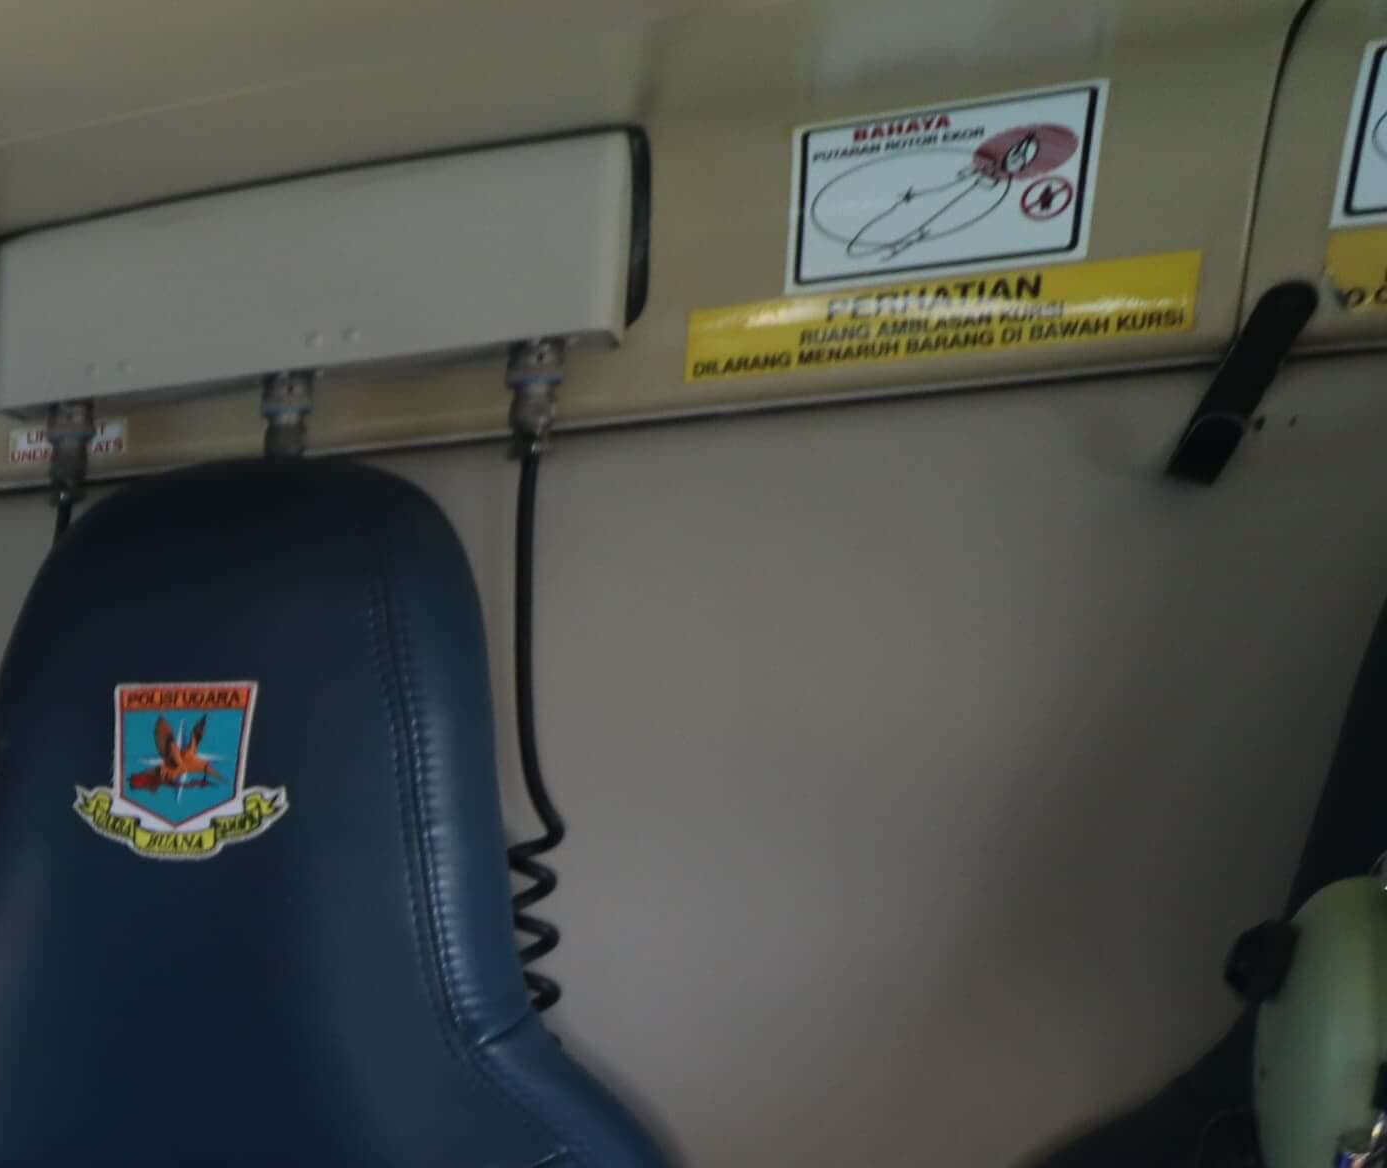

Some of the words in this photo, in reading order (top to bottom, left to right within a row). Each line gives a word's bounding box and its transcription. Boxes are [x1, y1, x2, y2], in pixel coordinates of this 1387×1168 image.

[853, 114, 952, 142] BAHAYA
[885, 133, 939, 152] ROTOR
[942, 126, 985, 143] EKOR
[826, 272, 1043, 322] PERHATIAN
[693, 353, 791, 378] DILARANG
[797, 340, 900, 366] MENARUH
[906, 328, 994, 354] BARANG
[1001, 325, 1023, 345] DI
[1029, 317, 1109, 341] BAWAH
[1116, 307, 1185, 332] KURSI
[799, 325, 870, 346] RUANG
